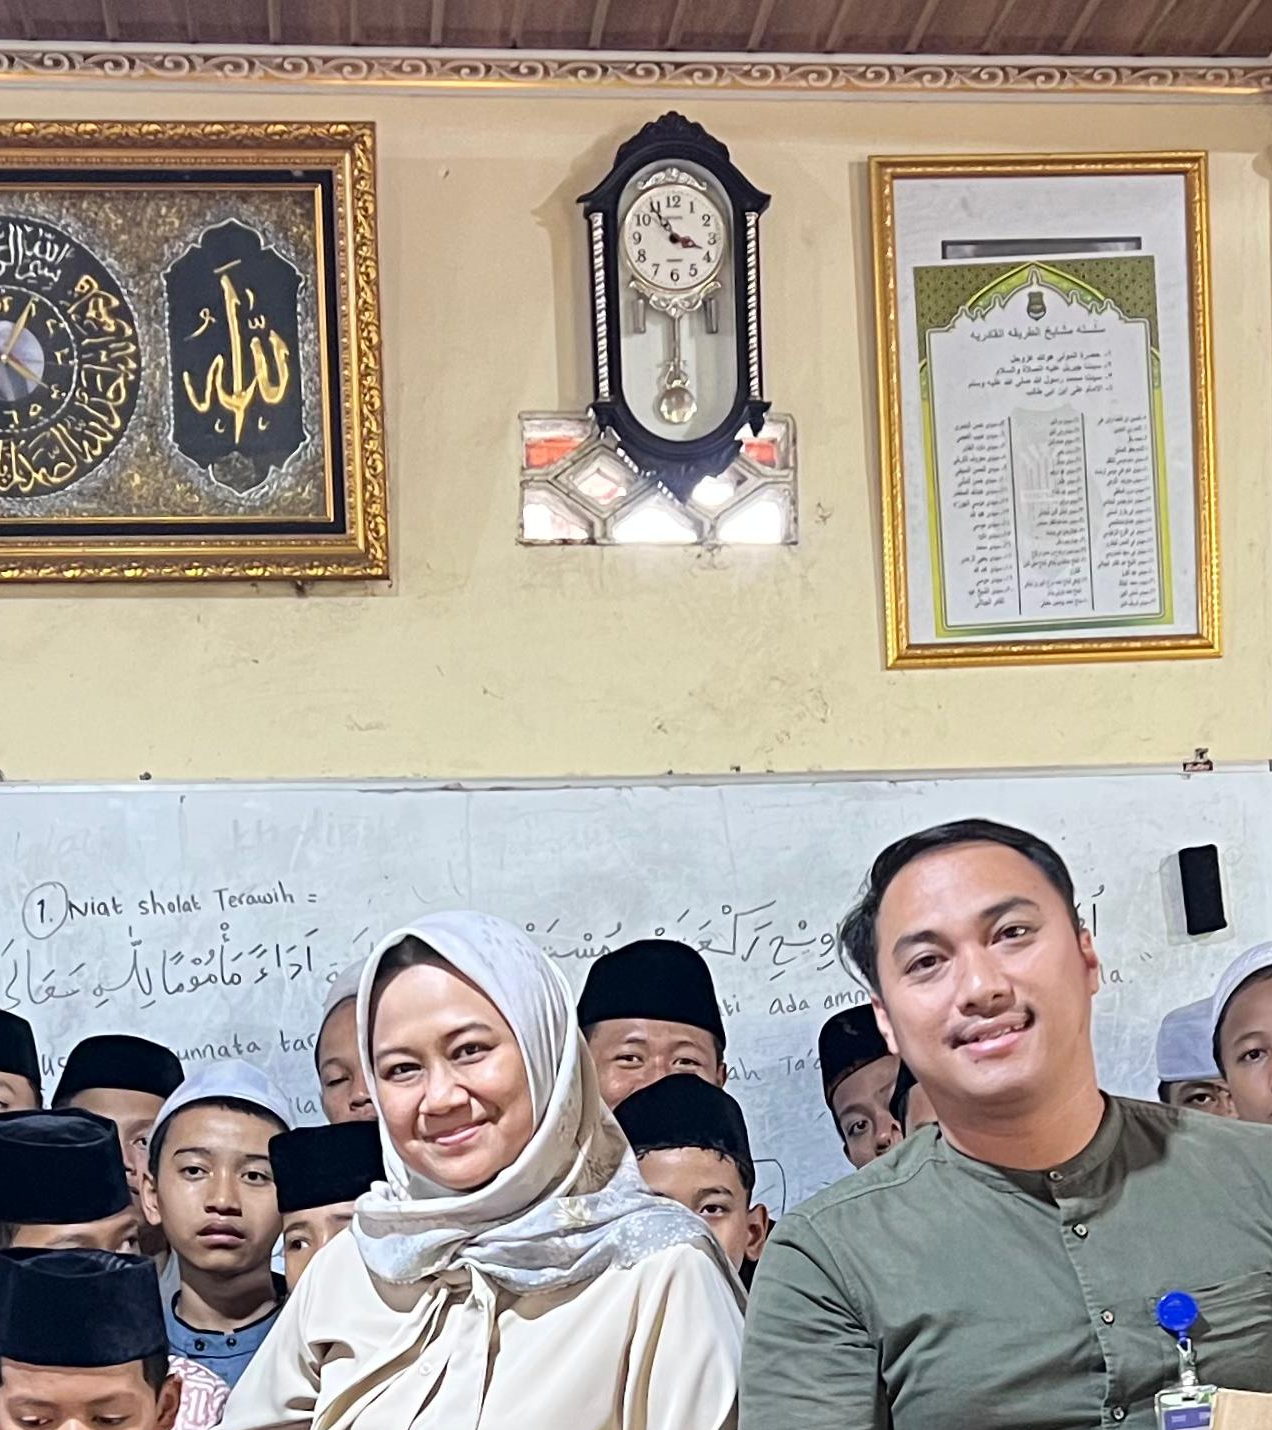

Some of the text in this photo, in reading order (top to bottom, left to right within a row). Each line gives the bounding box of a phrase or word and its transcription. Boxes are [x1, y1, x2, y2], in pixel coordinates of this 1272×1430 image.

[666, 195, 682, 208] 12
[635, 214, 651, 226] 10
[702, 214, 711, 227] 2
[633, 231, 642, 245] 9
[708, 232, 717, 245] 3
[637, 249, 647, 263] 8
[703, 251, 711, 263] 4
[652, 263, 660, 279] 7
[670, 268, 680, 281] 6
[689, 264, 698, 277] 5
[69, 896, 123, 919] Niat
[139, 890, 201, 916] sholat
[215, 881, 295, 911] Terawih
[175, 1033, 261, 1061] unnata
